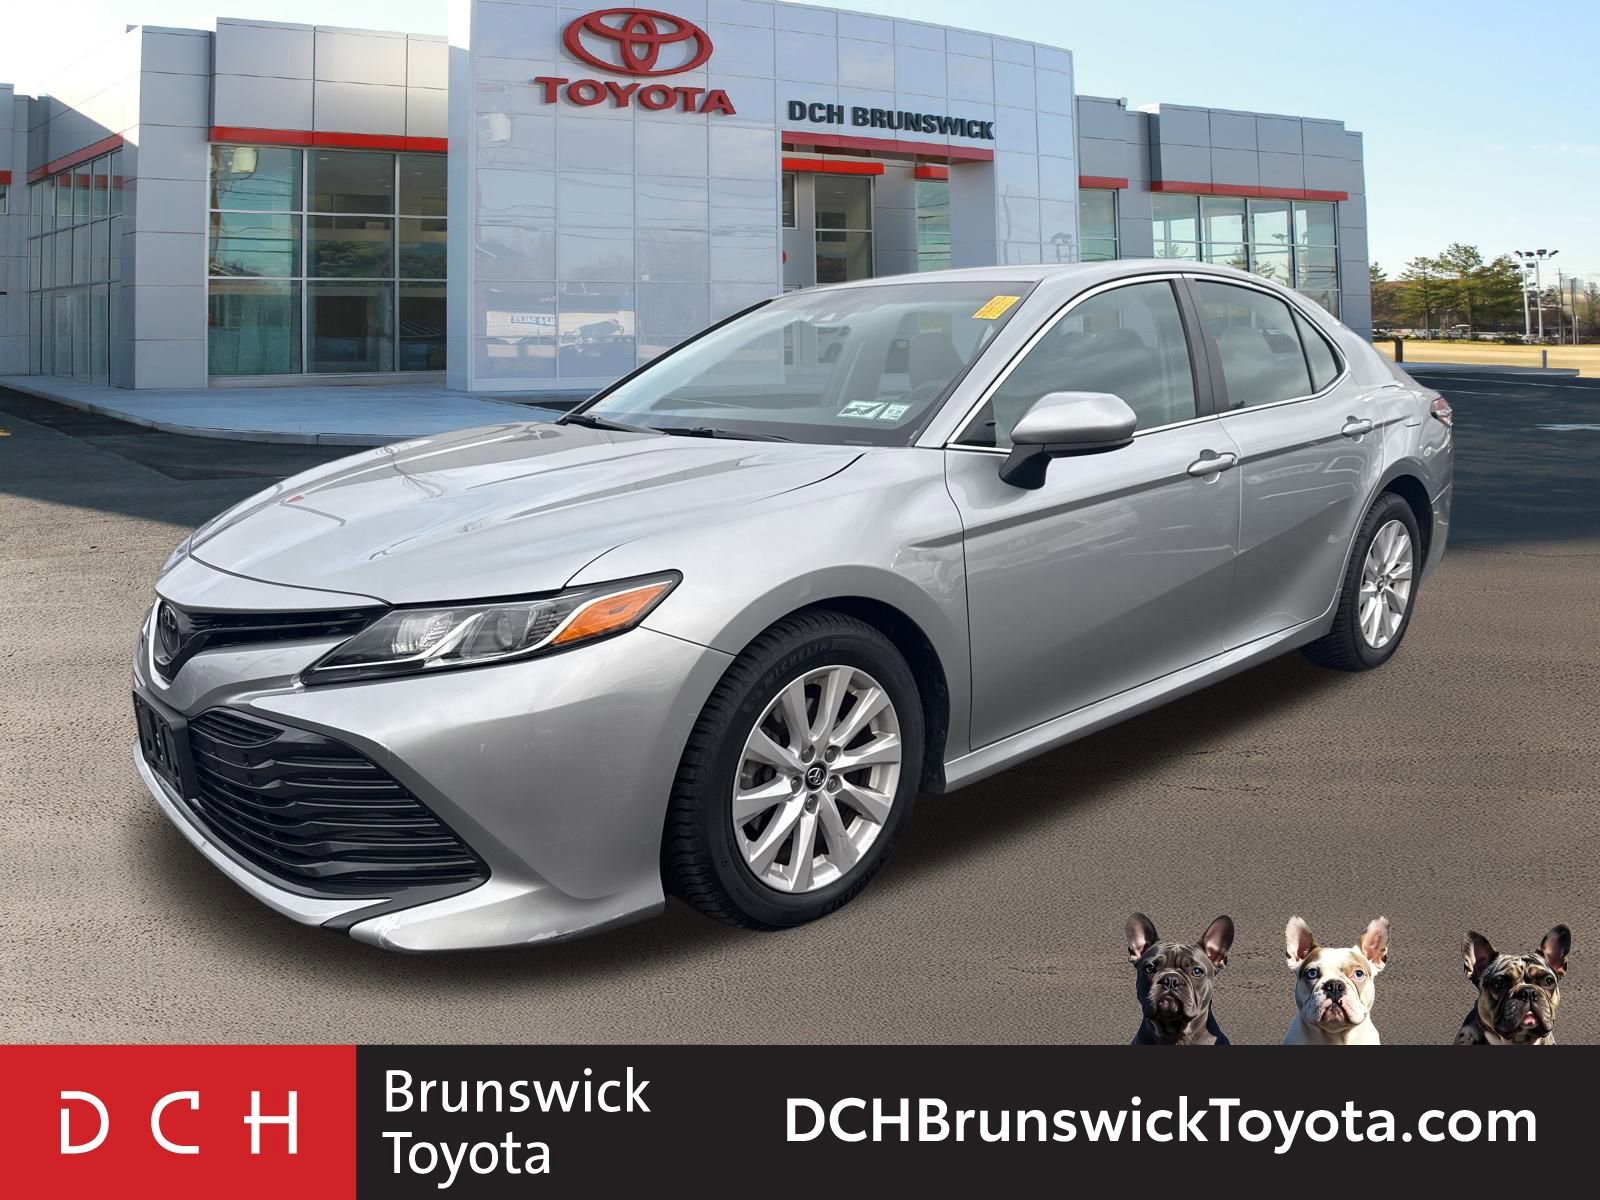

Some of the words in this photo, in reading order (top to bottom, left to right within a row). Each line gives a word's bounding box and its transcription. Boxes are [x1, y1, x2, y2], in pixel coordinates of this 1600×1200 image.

[535, 76, 736, 115] TOYOTA
[788, 100, 845, 125] DCH
[852, 106, 994, 140] BRUNSWICK
[764, 639, 834, 688] MICHELIN
